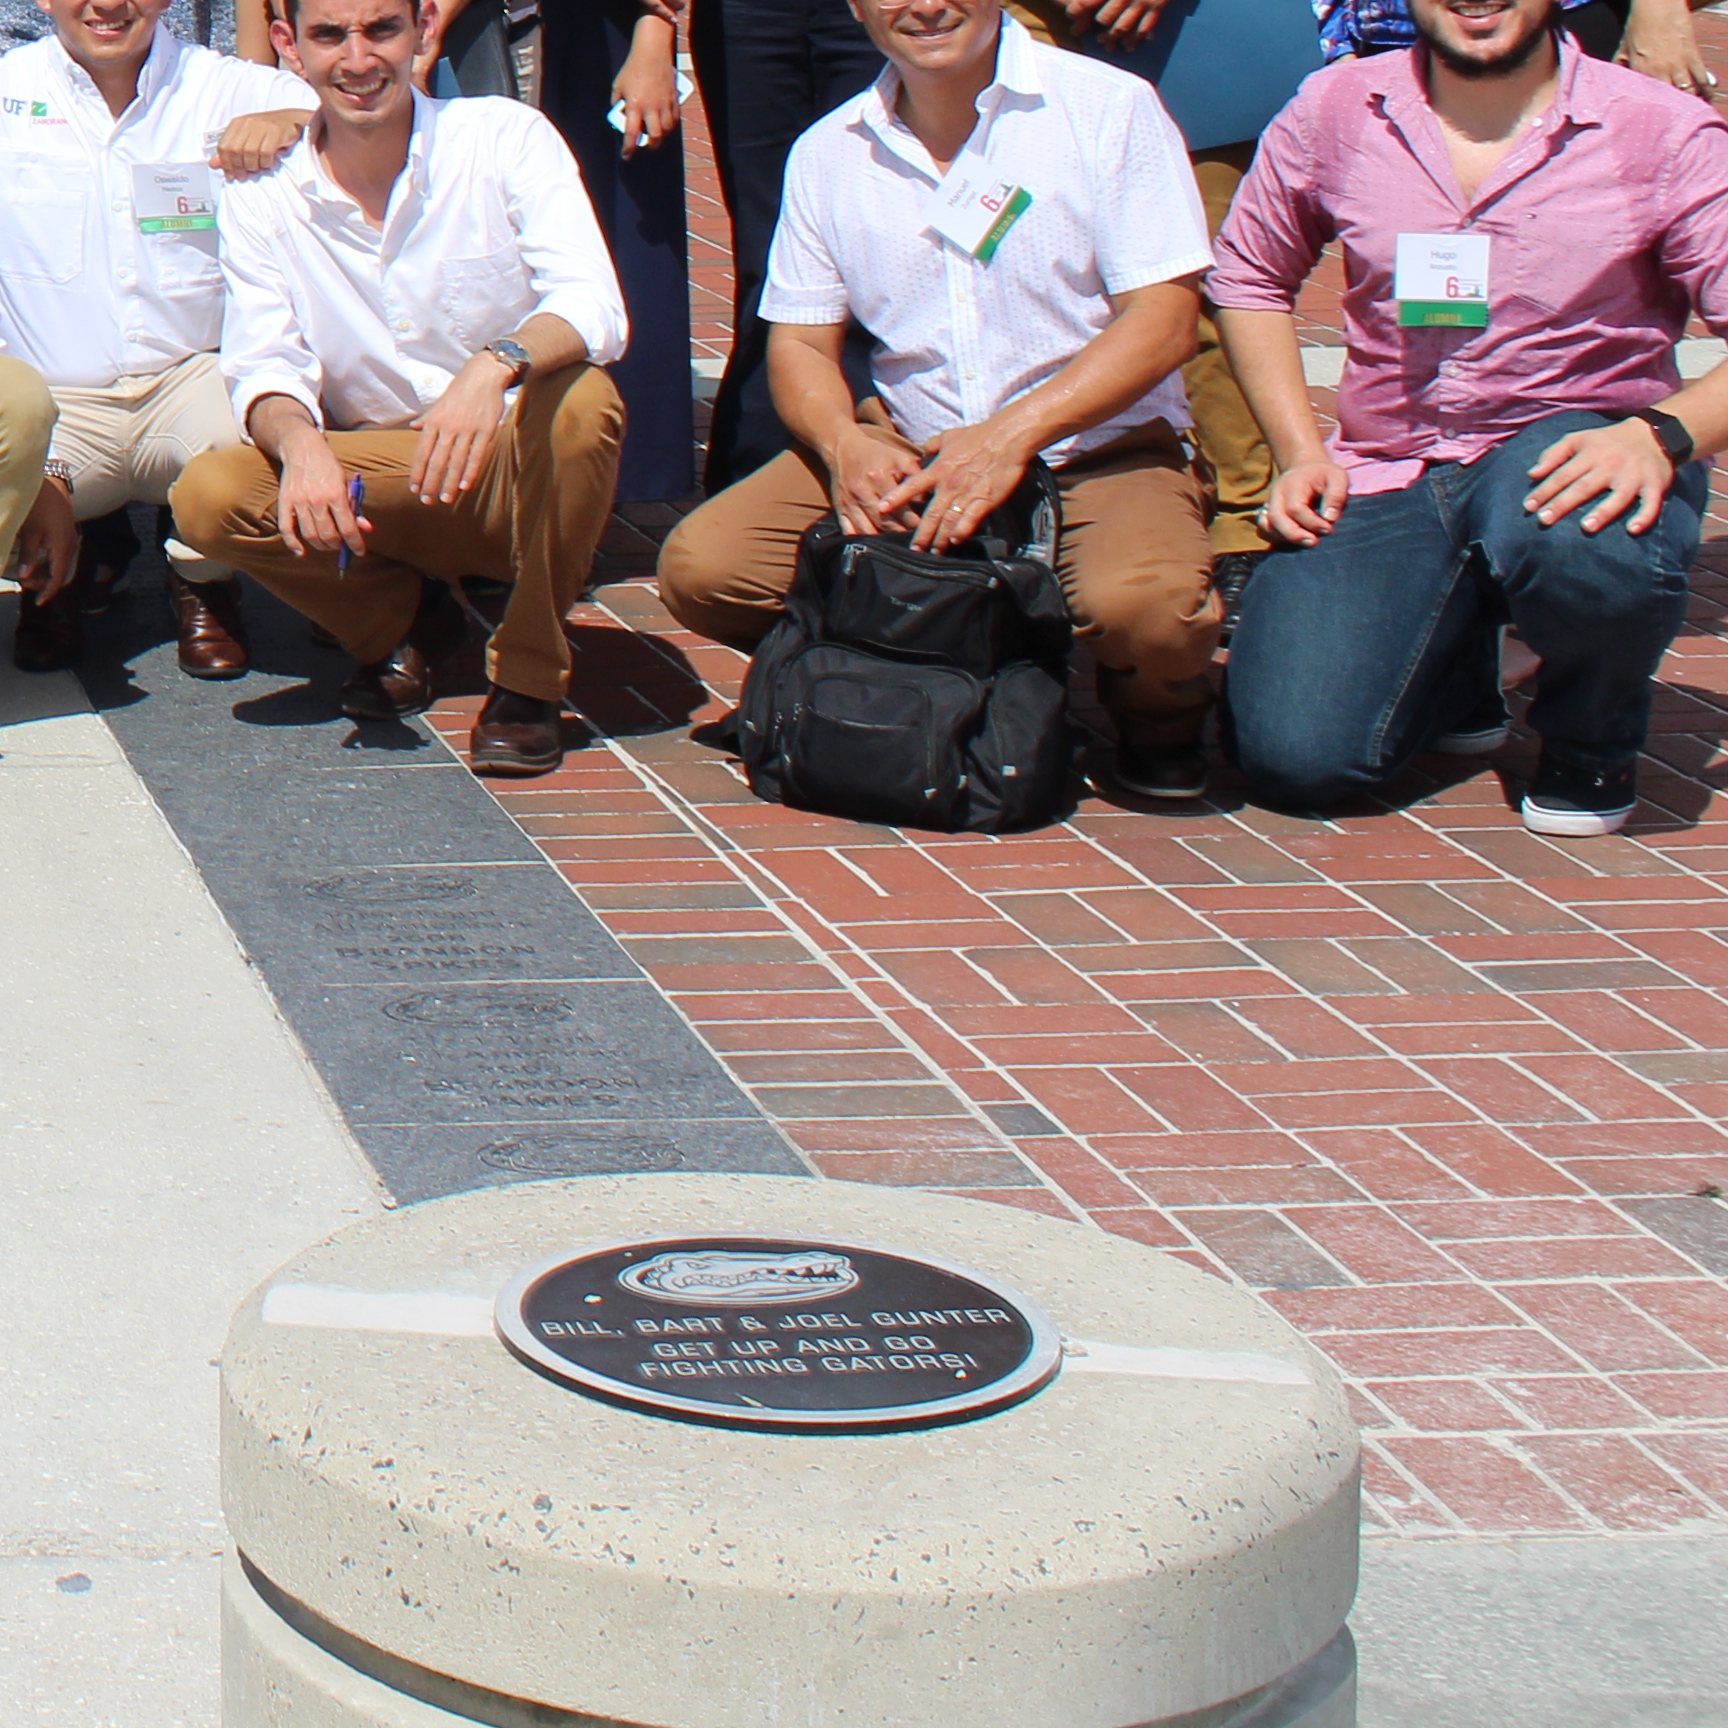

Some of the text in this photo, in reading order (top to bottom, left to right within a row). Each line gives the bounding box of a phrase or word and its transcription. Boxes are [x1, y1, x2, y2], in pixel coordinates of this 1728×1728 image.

[3, 97, 27, 116] UF
[154, 175, 190, 184] Oswaldo
[1430, 250, 1457, 260] Hugo
[335, 945, 537, 958] BRANDON
[541, 1307, 1013, 1339] BILL, BART & JOEL GUNTER
[654, 1334, 936, 1359] GET UP AND GO
[641, 1352, 977, 1379] FIGHTING GATORS!
